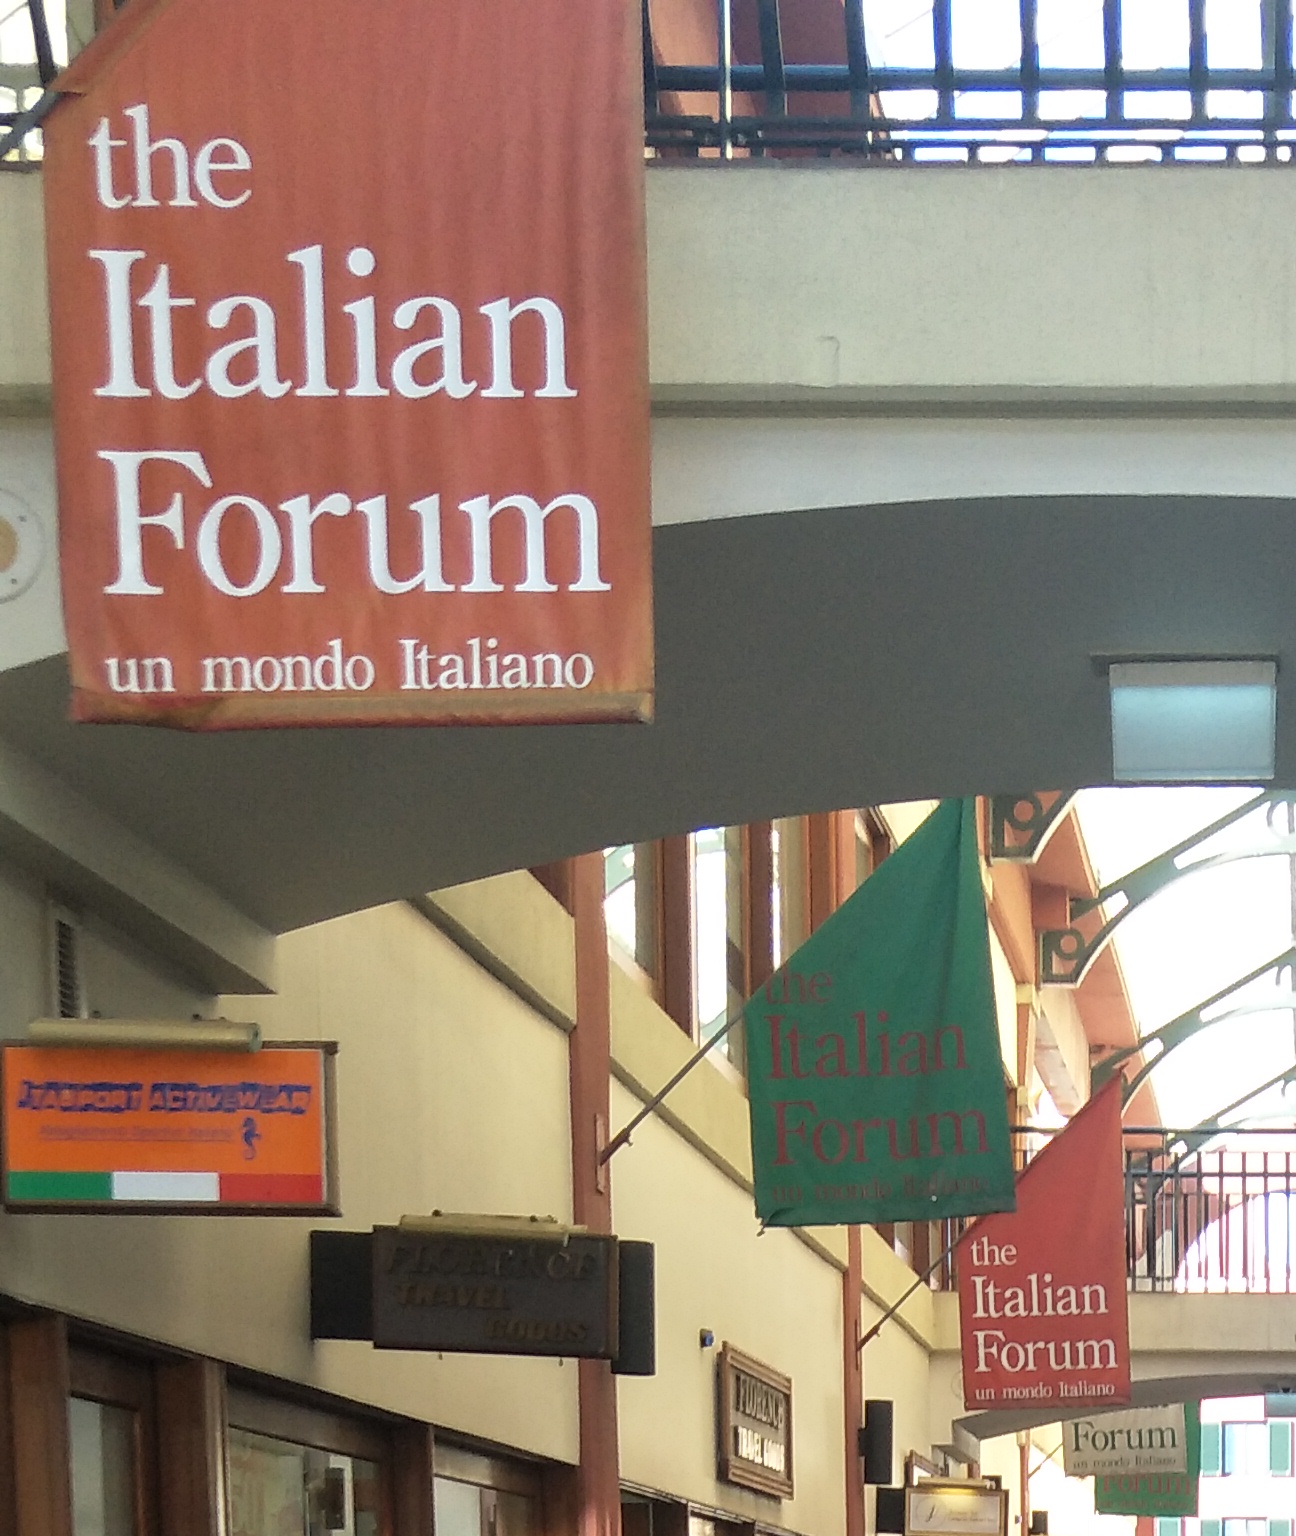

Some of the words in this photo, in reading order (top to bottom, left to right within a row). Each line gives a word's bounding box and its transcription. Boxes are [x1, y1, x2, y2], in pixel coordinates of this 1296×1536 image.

[88, 103, 252, 209] the
[88, 244, 578, 399] Italian
[97, 450, 612, 597] Forum
[104, 657, 176, 694] un
[201, 638, 375, 692] mondo
[398, 637, 594, 691] Italiano
[764, 963, 834, 1005] the
[763, 1009, 971, 1081] Italian
[770, 1099, 994, 1166] Forum
[970, 1235, 1017, 1266] the
[970, 1273, 1109, 1319] Italian
[972, 1330, 1118, 1373] Forum
[975, 1388, 995, 1400] un
[1003, 1382, 1053, 1399] mondo
[1059, 1380, 1115, 1397] Italiano
[1070, 1420, 1178, 1453] Forum
